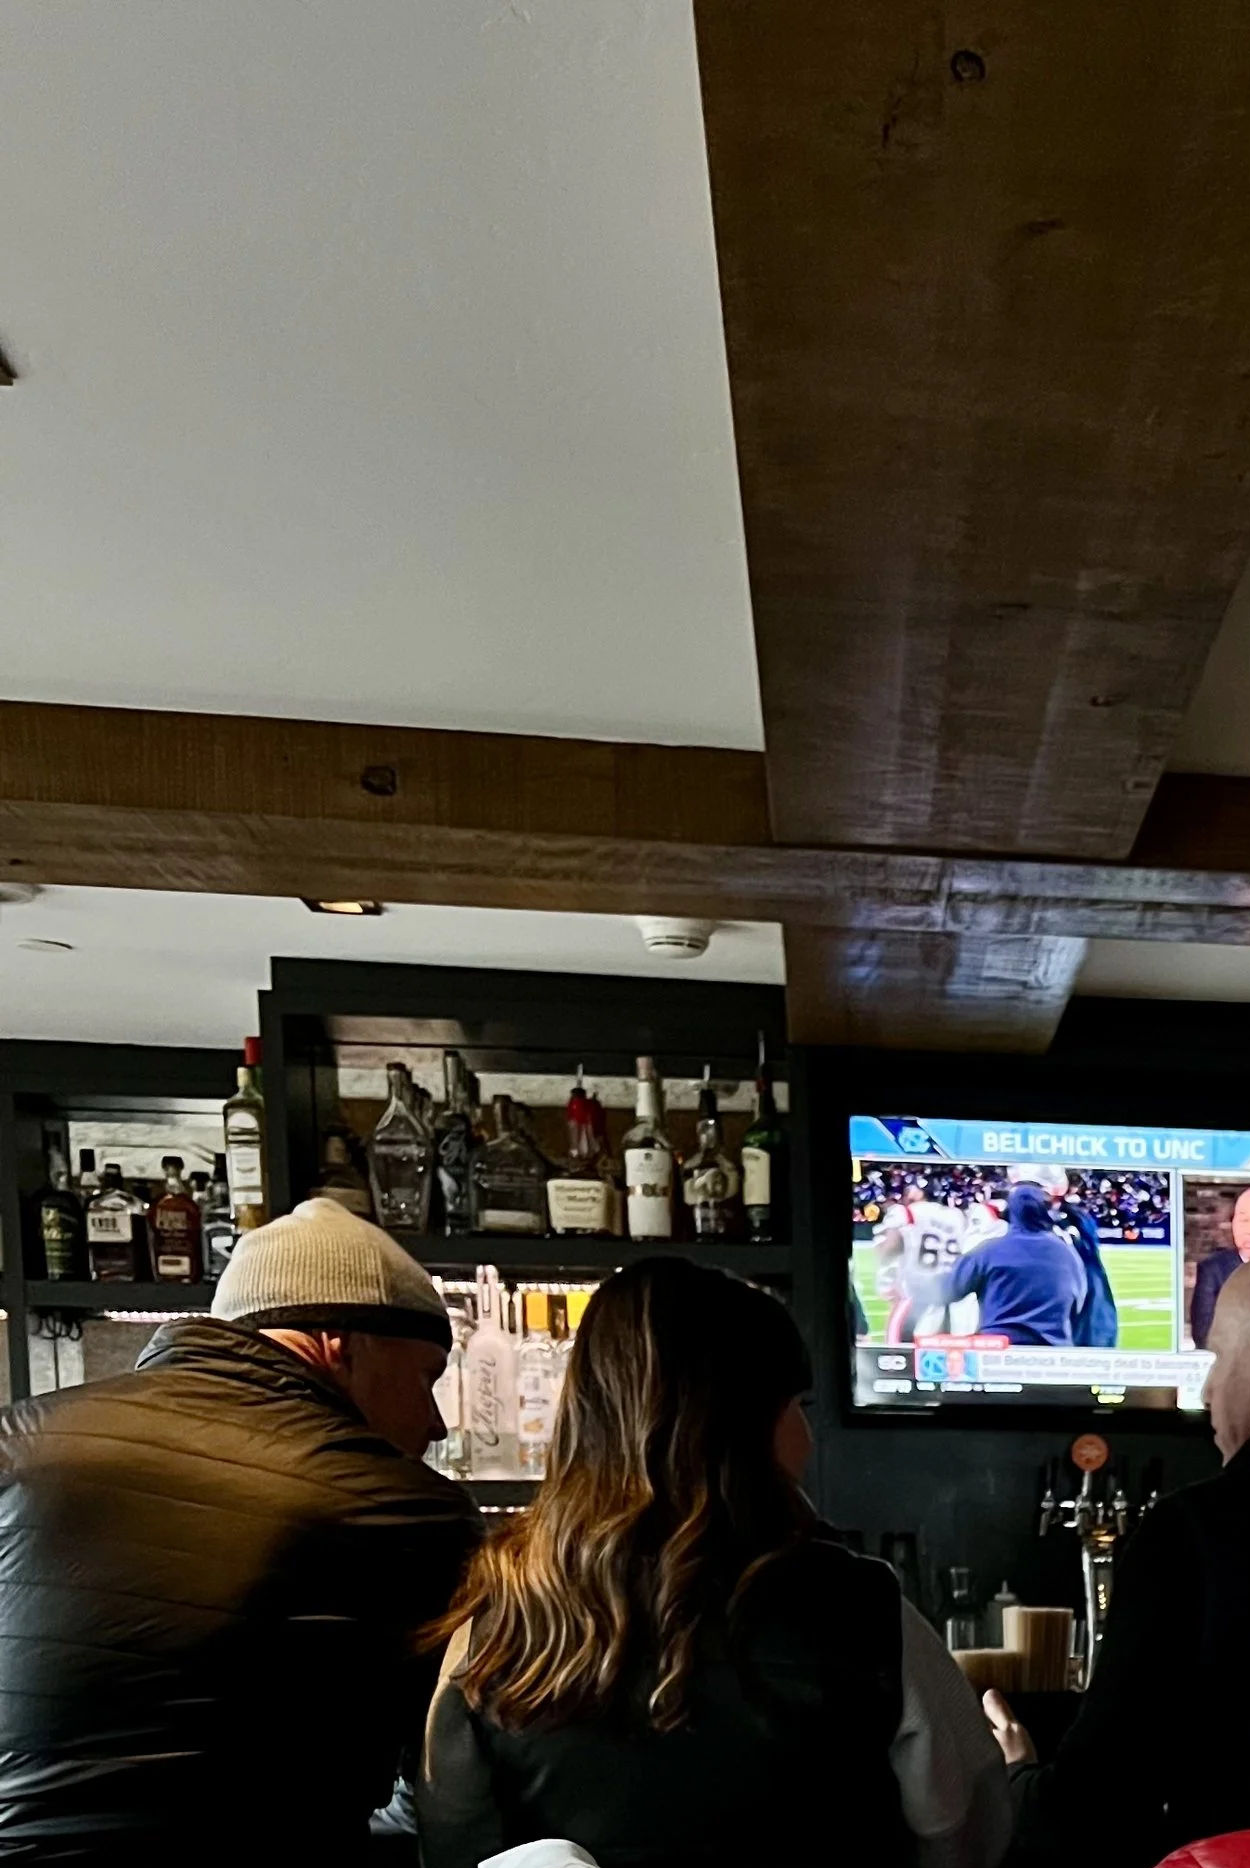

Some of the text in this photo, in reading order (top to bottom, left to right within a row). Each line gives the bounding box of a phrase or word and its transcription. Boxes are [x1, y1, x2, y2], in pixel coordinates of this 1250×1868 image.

[982, 1131, 1206, 1160] BELICHICK TO UNC
[1004, 1355, 1055, 1367] Belichick
